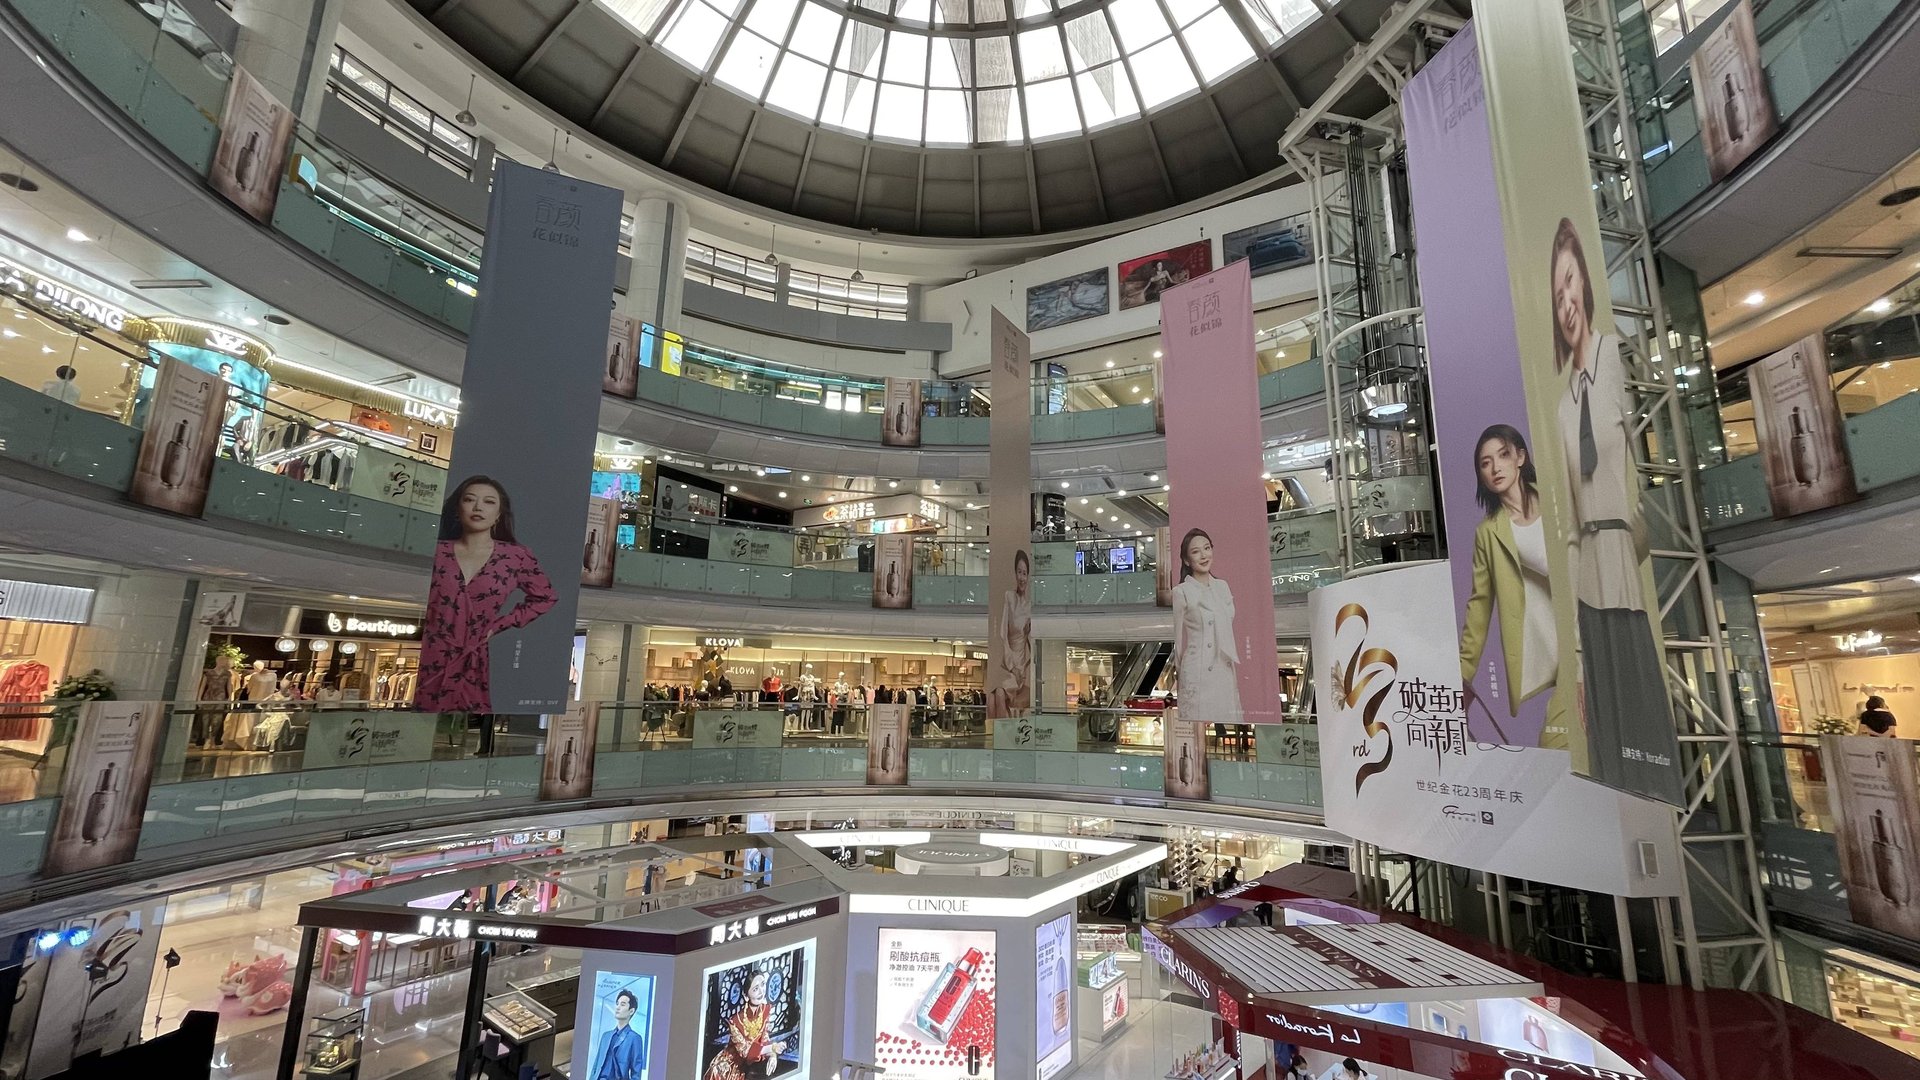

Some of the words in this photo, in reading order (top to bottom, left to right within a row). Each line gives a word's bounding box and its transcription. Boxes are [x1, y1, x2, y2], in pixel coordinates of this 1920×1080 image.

[34, 278, 125, 334] DILONG
[346, 617, 417, 636] Boutique
[705, 637, 741, 647] KLOVA
[730, 666, 755, 675] KLOVA
[1352, 739, 1371, 758] rd
[1416, 779, 1524, 804] 世纪金花23周年庆
[907, 898, 970, 912] CLINIQUE
[1160, 946, 1210, 999] CLARINS
